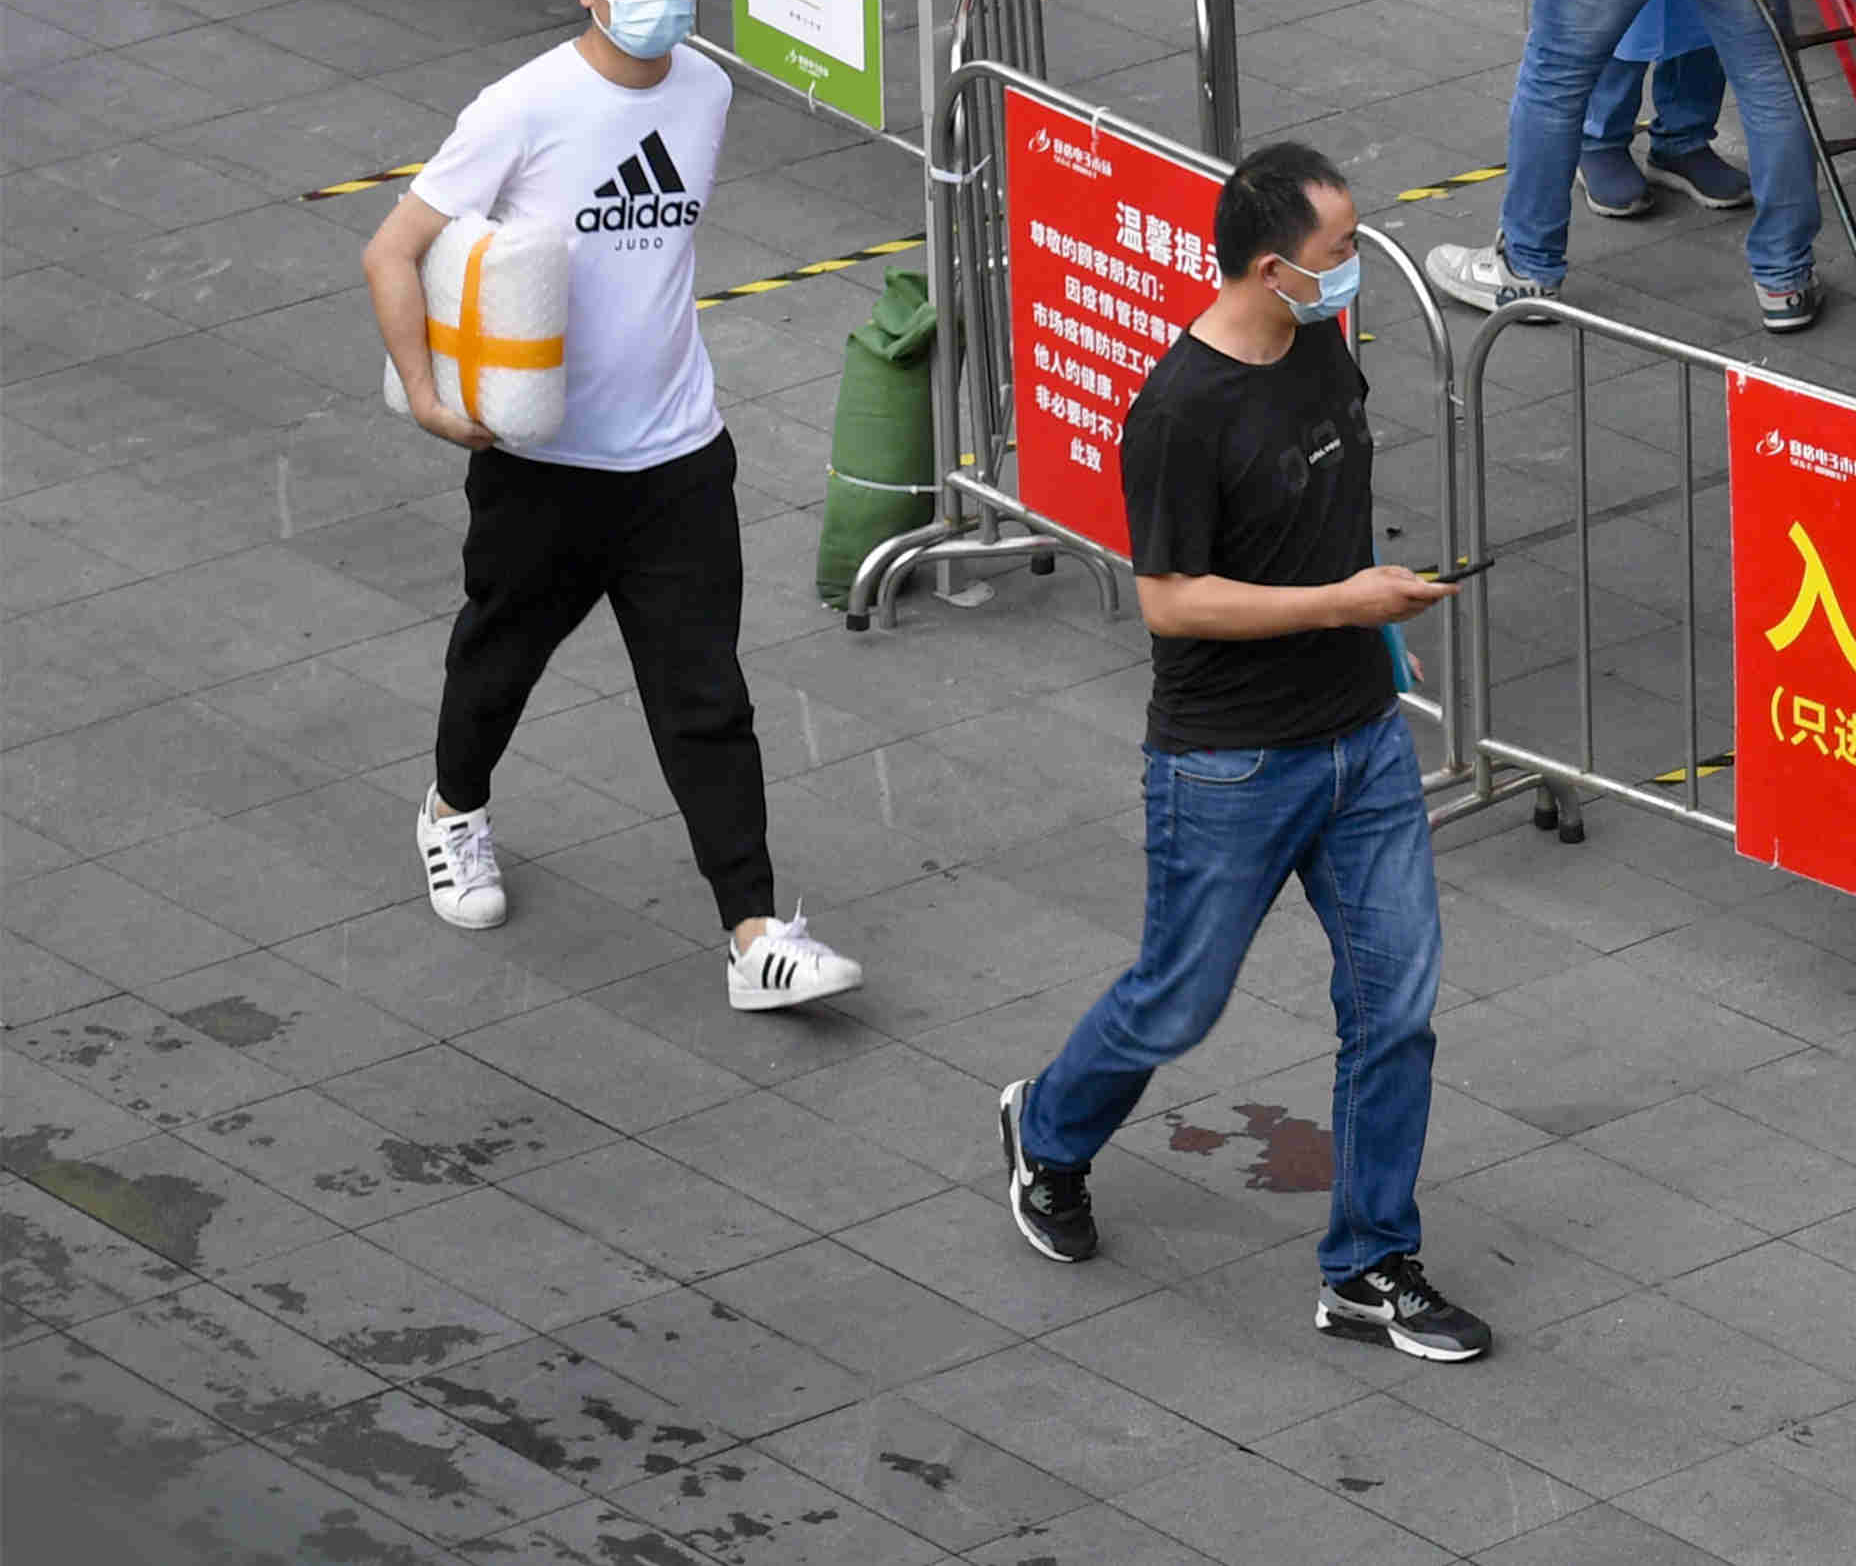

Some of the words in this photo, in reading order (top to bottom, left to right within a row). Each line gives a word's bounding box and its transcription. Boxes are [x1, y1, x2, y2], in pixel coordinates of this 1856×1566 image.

[575, 194, 701, 234] adidas
[614, 237, 665, 252] JUDO
[1030, 219, 1165, 303] 尊敬的顾客朋友们：
[1069, 436, 1103, 473] 此致
